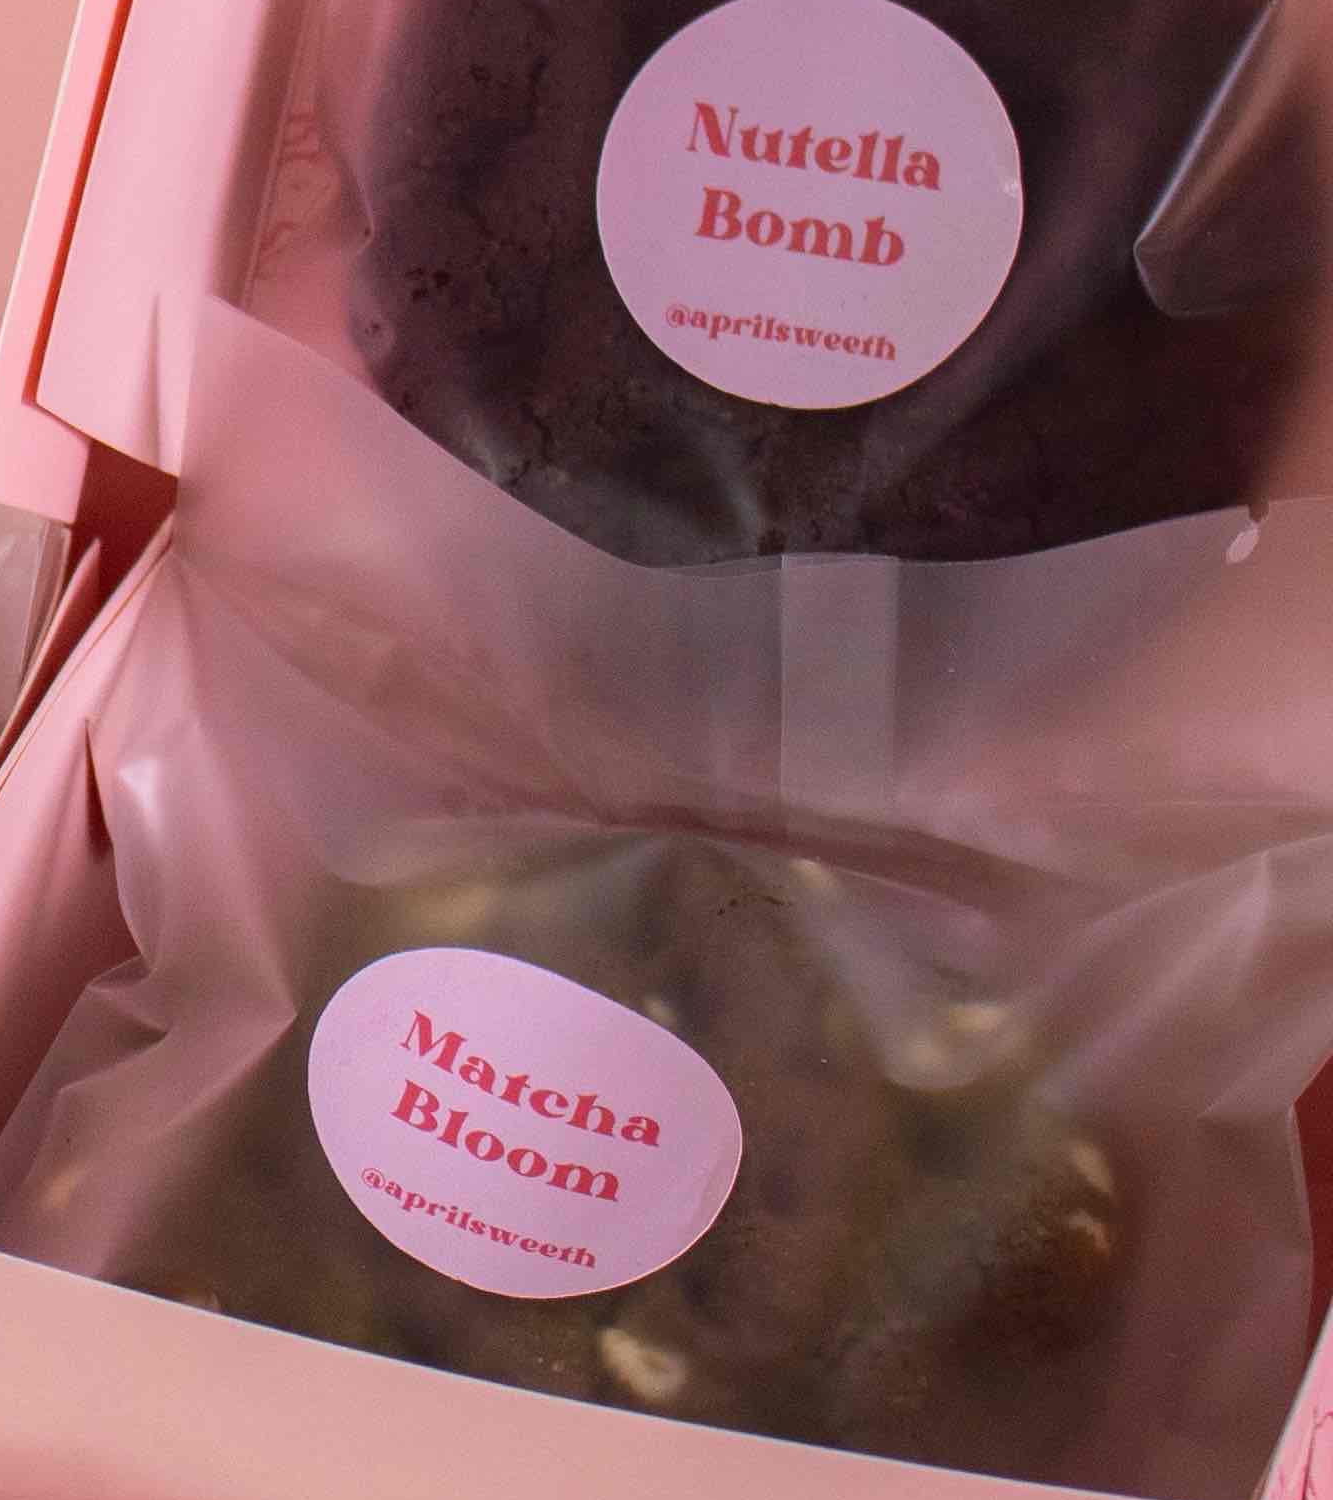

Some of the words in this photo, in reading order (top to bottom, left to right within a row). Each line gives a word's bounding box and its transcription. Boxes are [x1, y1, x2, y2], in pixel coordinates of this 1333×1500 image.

[685, 101, 942, 191] Nutella
[694, 186, 905, 267] Bomb
[665, 304, 897, 361] @aprilsweeth
[399, 1010, 660, 1147] Matcha
[391, 1079, 619, 1201] Bloom
[361, 1167, 596, 1269] @aprilsweeth
